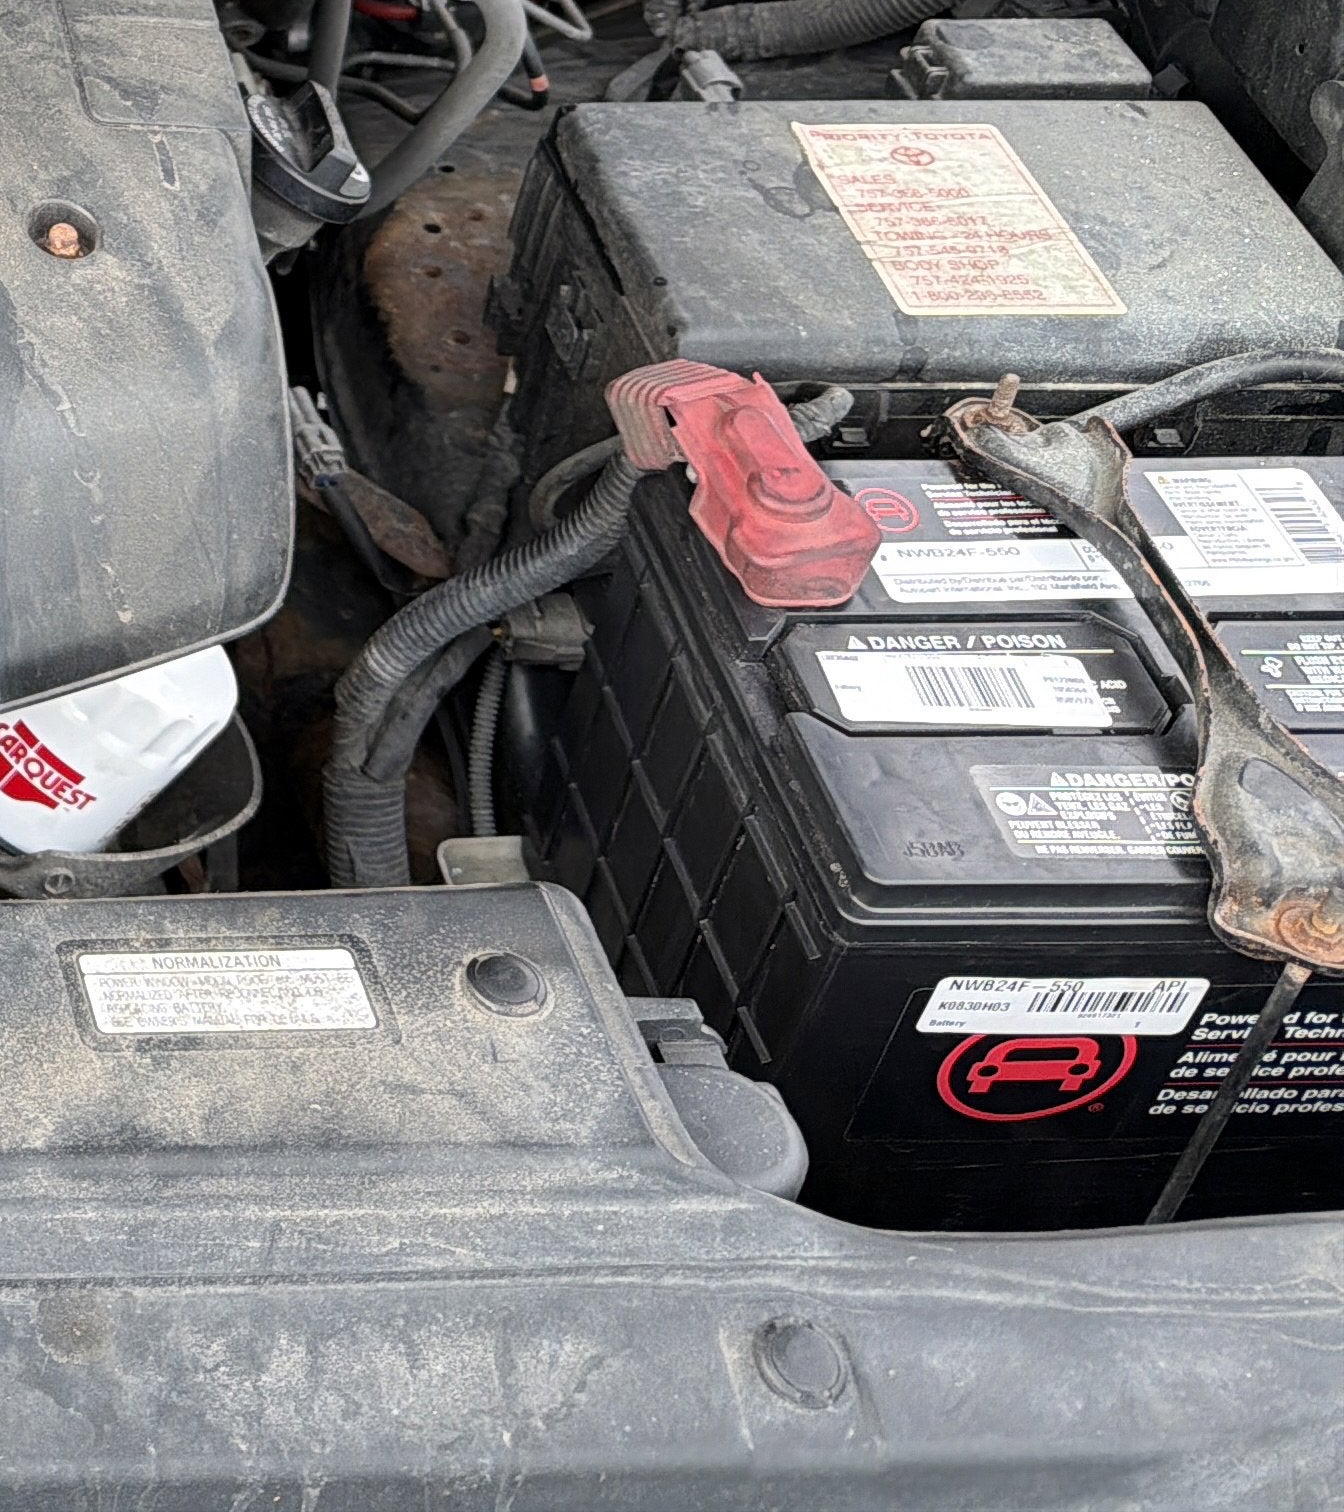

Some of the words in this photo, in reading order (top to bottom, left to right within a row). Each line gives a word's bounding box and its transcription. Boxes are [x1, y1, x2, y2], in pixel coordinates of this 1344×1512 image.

[912, 131, 993, 142] TOYOTA
[837, 173, 896, 184] SALES
[856, 202, 936, 213] SERVICE
[874, 231, 946, 241] TOWING
[986, 229, 1053, 241] HOURS
[892, 260, 941, 271] BODY
[946, 259, 1000, 271] SHOP
[896, 546, 1021, 559] NWB24F-550
[867, 636, 962, 650] DANGER
[980, 634, 1068, 649] POISON
[1099, 679, 1128, 690] ACID
[1064, 773, 1195, 788] DANGER/PO
[151, 954, 282, 970] NORMALIZATION
[1151, 980, 1188, 993] API
[928, 1019, 967, 1028] Battery
[1199, 1011, 1302, 1026] Powed
[1303, 1011, 1339, 1025] for
[1190, 1026, 1254, 1041] Servi
[1284, 1026, 1344, 1039] Techn
[1176, 1049, 1278, 1065] Alimeé
[1280, 1051, 1338, 1066] pour
[1169, 1065, 1200, 1079] de
[1202, 1064, 1286, 1078] seice
[1287, 1063, 1344, 1080] profe
[1156, 1087, 1299, 1102] Desallado
[1148, 1103, 1178, 1115] de
[1180, 1102, 1272, 1115] seicio
[1272, 1101, 1344, 1117] profes
